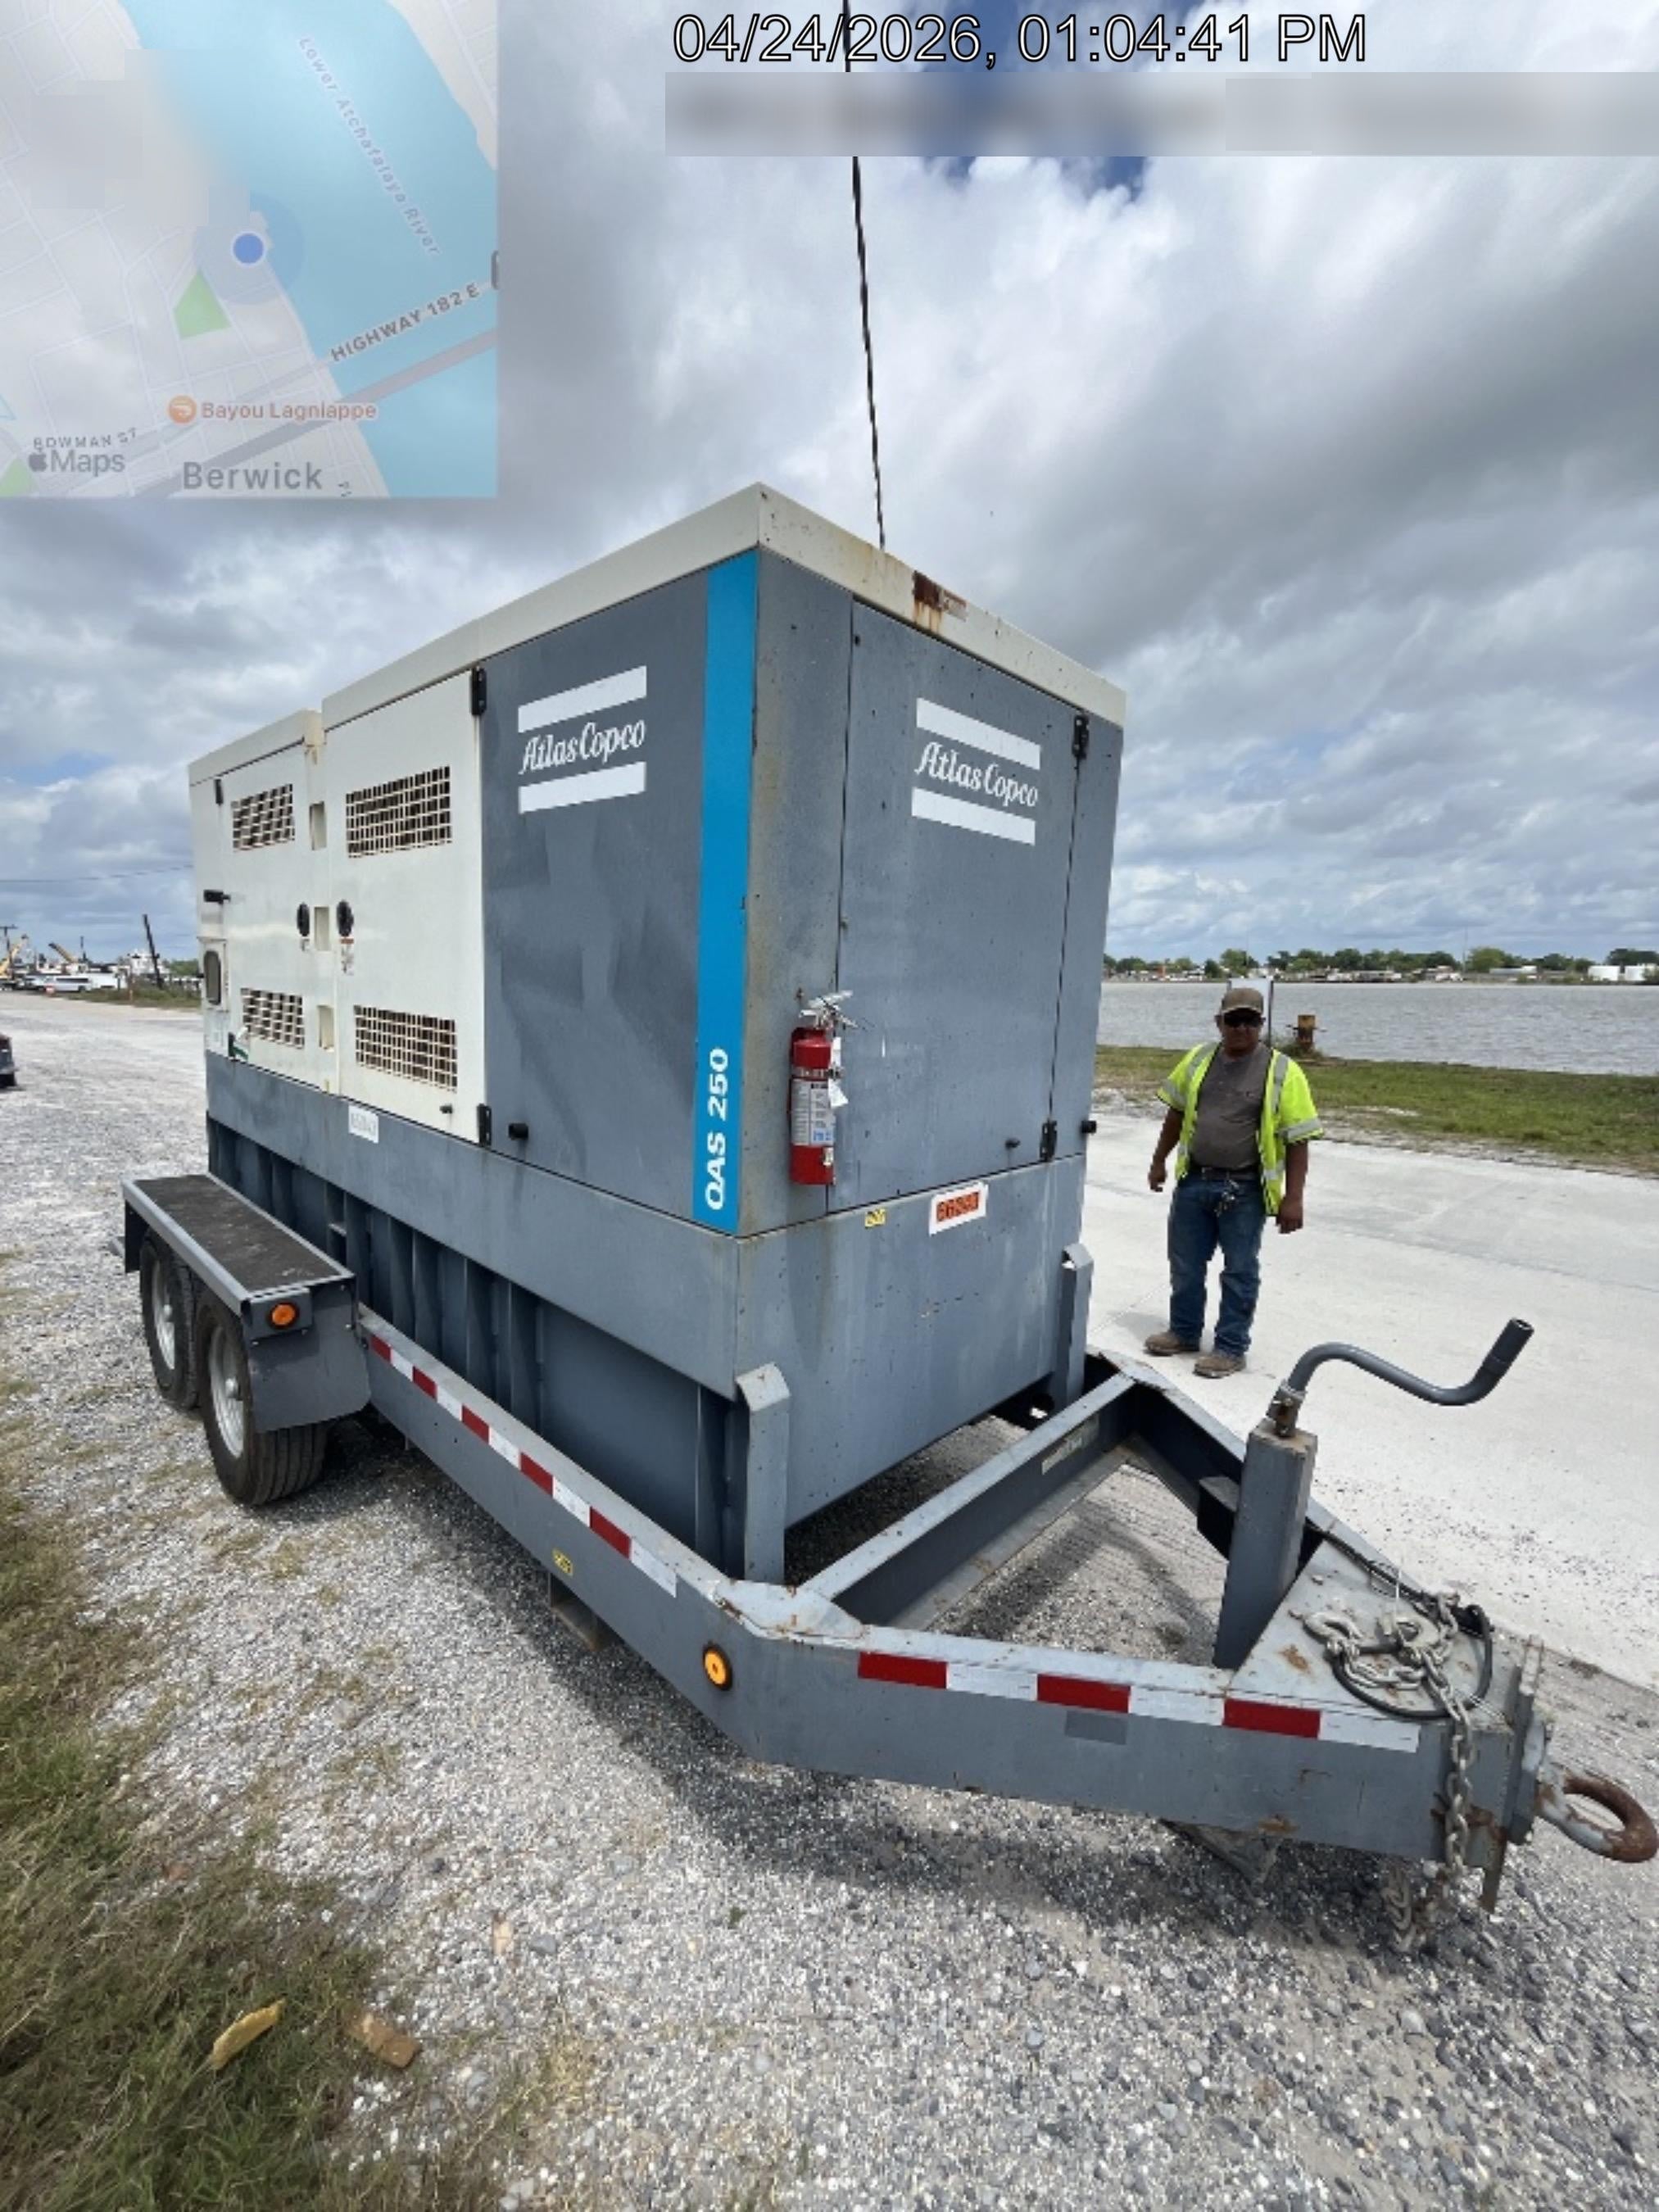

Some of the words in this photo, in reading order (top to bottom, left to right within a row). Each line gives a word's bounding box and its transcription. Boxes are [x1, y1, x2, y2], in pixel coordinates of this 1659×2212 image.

[518, 733, 578, 775] Atlas
[579, 719, 646, 764] Copco
[913, 741, 983, 791] Atlas
[984, 762, 1039, 807] Copco
[707, 1046, 729, 1122] 250
[705, 1130, 727, 1211] QAS
